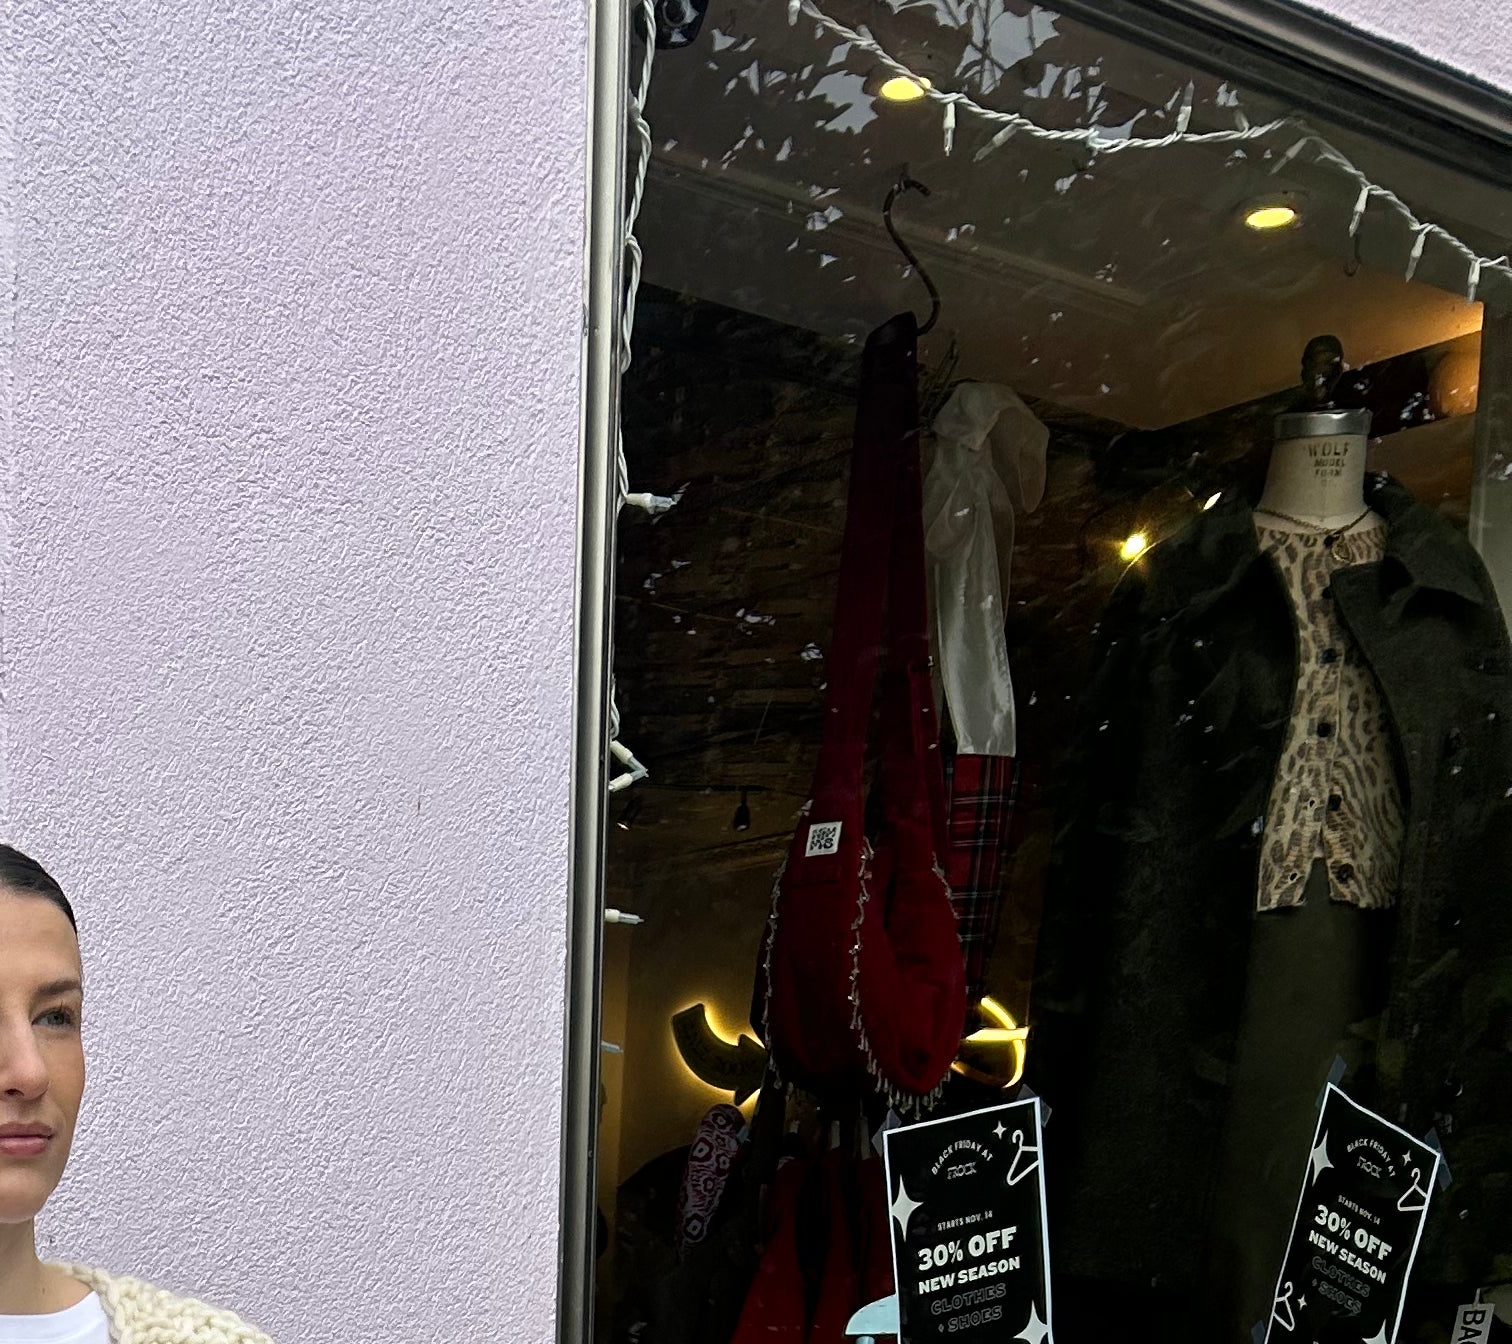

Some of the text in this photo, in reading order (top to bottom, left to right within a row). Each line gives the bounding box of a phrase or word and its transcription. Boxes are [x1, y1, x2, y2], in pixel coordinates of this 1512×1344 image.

[931, 1140, 993, 1175] BLACK FRIDAY AT
[937, 1217, 963, 1231] STARTS
[1315, 1204, 1392, 1260] 30% OFF
[918, 1226, 1017, 1271] 30% OFF
[1309, 1230, 1386, 1284] NEW SEASON
[918, 1256, 1020, 1294] NEW SEASON
[1312, 1256, 1370, 1297] CLOTHES
[931, 1282, 1006, 1315] CLOTHES
[1318, 1281, 1362, 1314] SHOES
[948, 1305, 1002, 1332] SHOES
